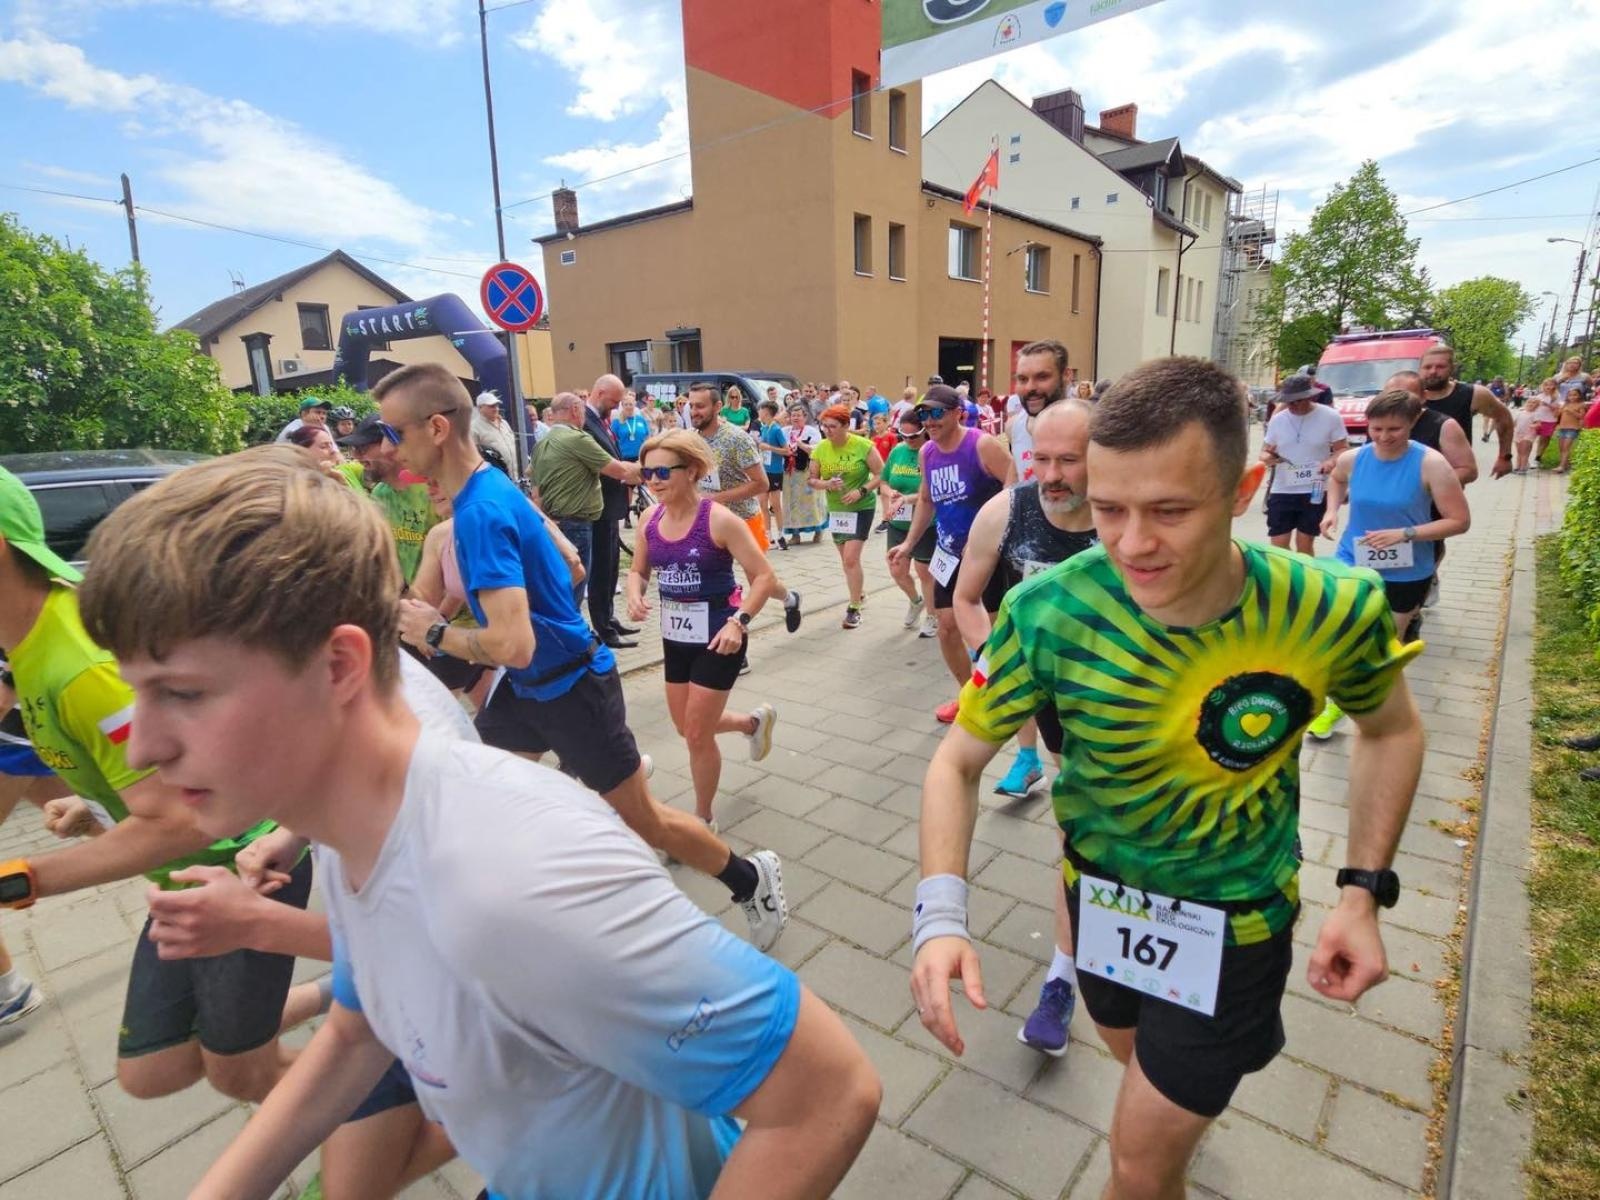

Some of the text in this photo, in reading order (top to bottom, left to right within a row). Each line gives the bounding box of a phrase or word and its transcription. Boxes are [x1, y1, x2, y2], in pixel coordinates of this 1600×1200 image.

[359, 312, 414, 336] START
[1295, 469, 1312, 479] 168
[1367, 549, 1399, 561] 203
[670, 616, 693, 631] 174
[1088, 884, 1151, 920] XXIX
[1156, 903, 1201, 921] RAISKI
[1156, 916, 1216, 938] EKOLOGICZNY
[1116, 926, 1179, 972] 167
